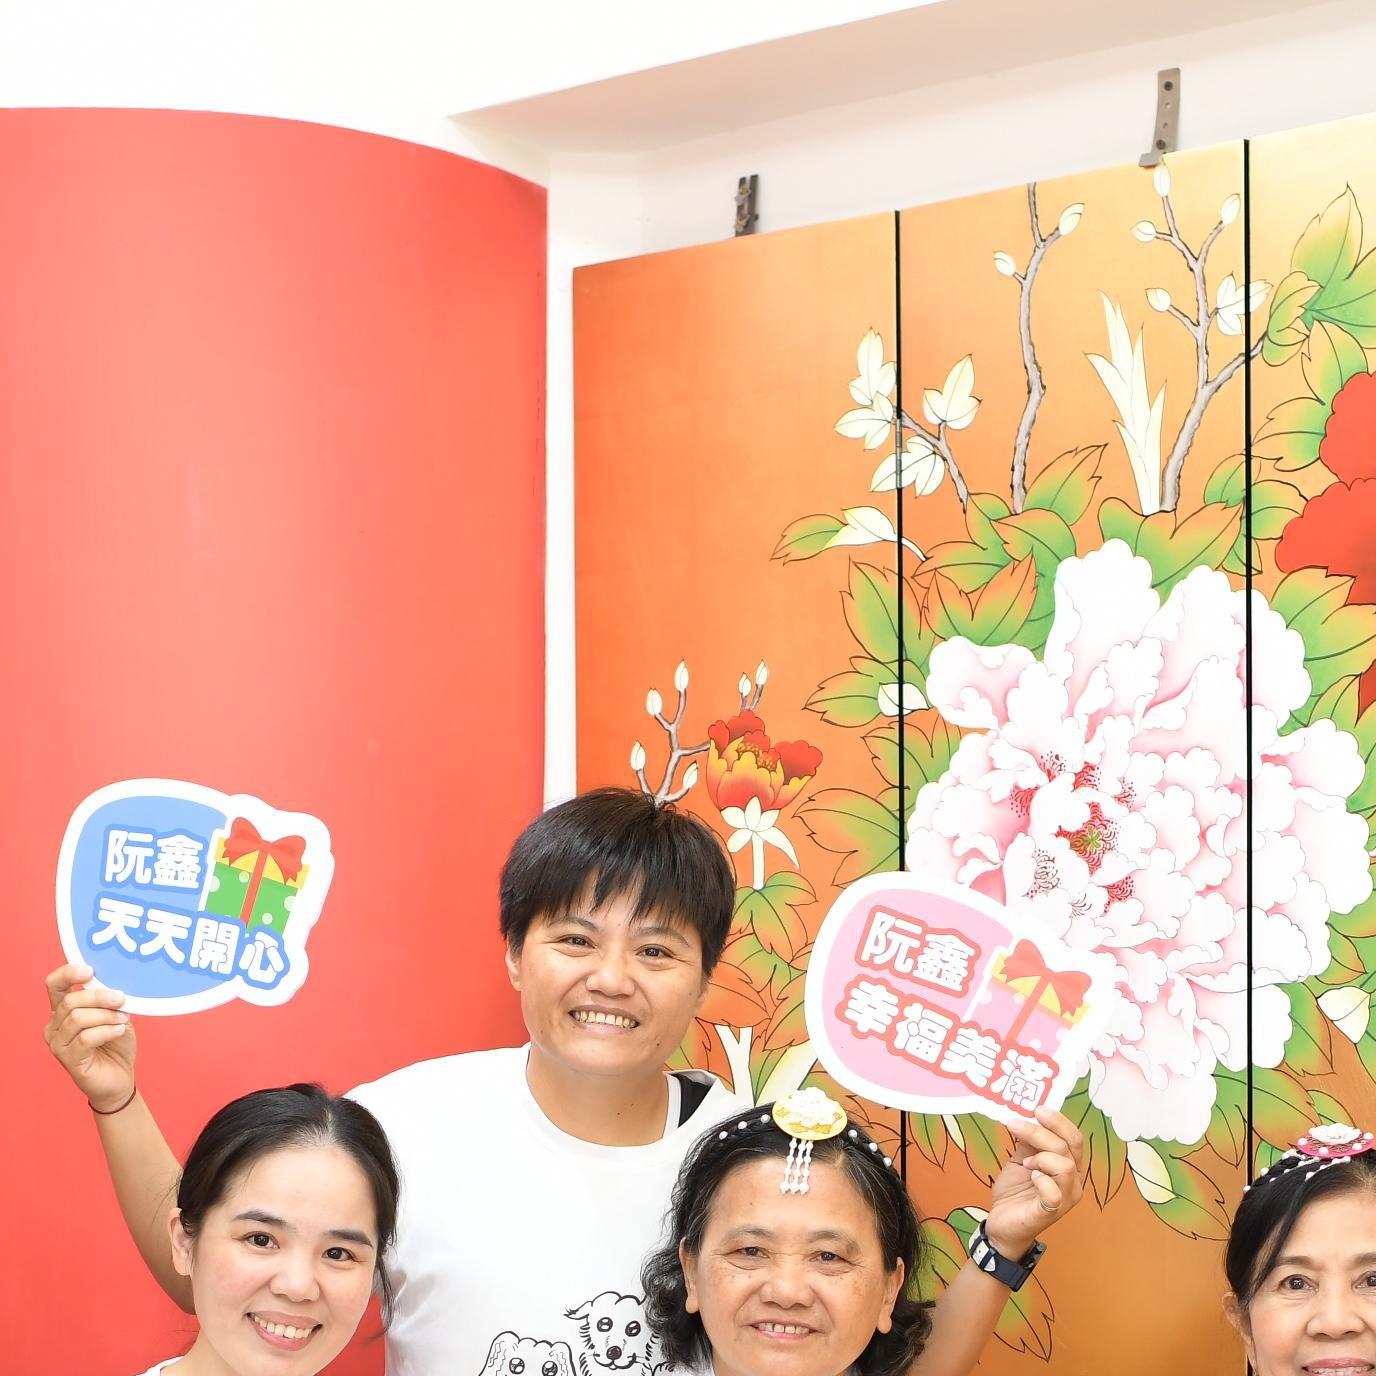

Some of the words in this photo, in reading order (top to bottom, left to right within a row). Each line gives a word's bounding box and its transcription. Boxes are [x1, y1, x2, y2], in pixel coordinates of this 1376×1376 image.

[104, 829, 204, 889] 阮鑫
[91, 897, 285, 984] 天天開心
[860, 910, 976, 992] 阮鑫
[844, 980, 1054, 1112] 幸福美滿
